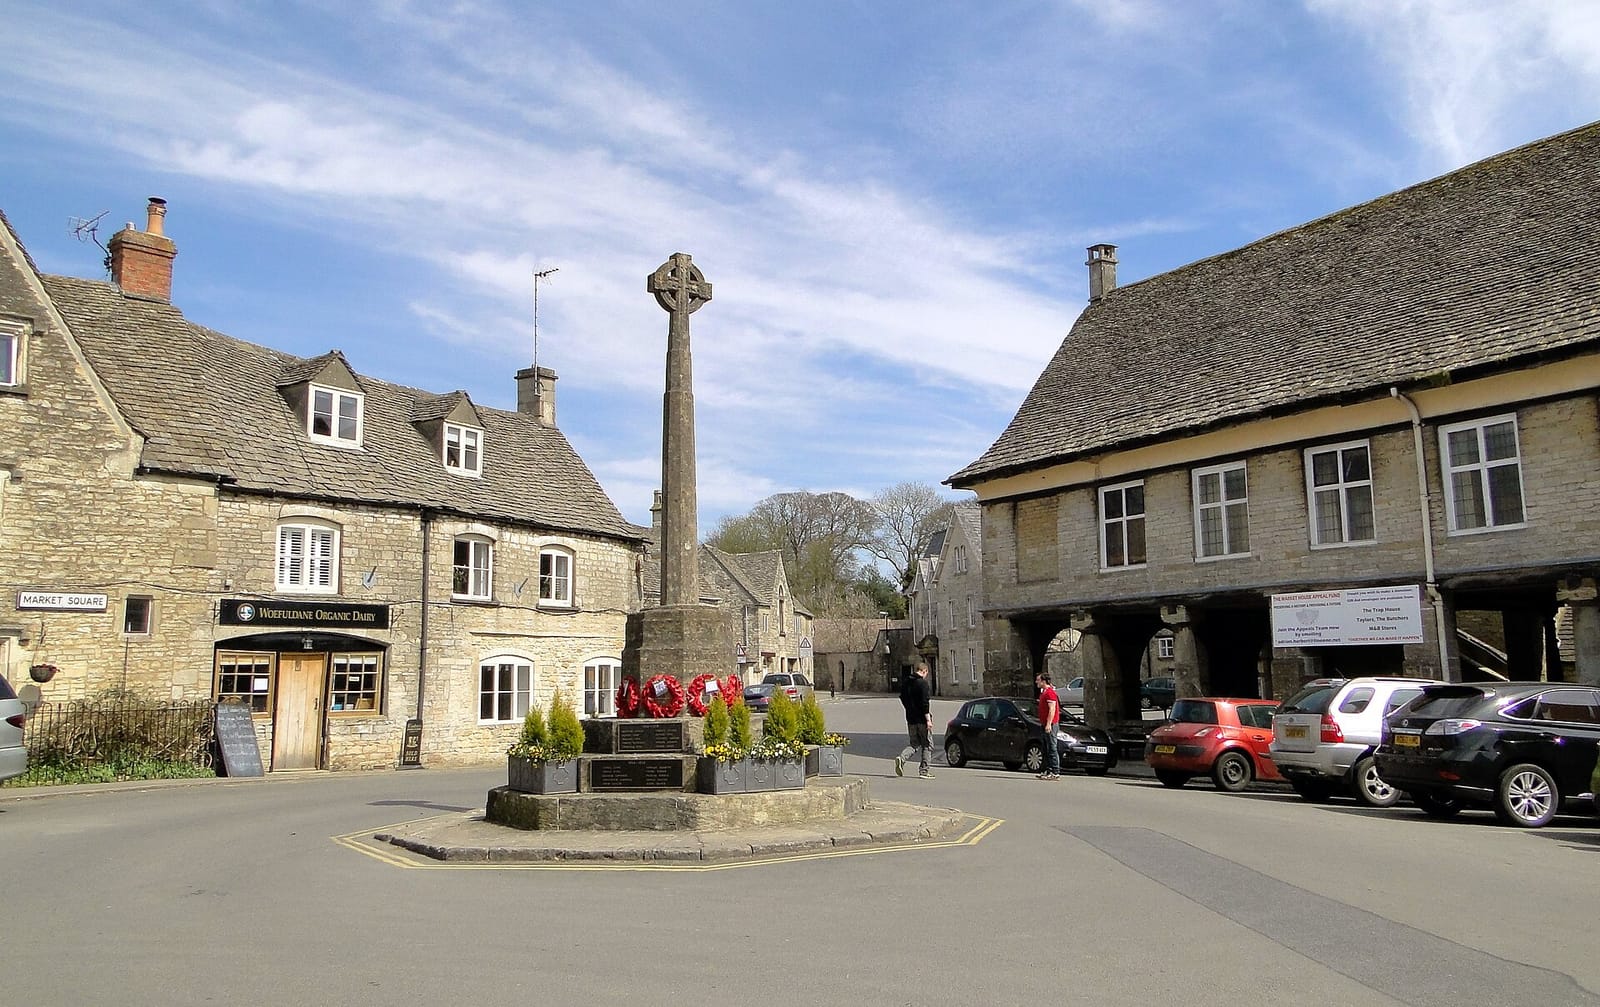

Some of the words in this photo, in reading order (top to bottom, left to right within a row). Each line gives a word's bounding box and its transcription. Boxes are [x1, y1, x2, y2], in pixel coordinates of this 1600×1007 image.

[23, 595, 63, 604] MARKET
[68, 596, 104, 606] SQUARE
[260, 608, 314, 620] WOEFULDANE
[316, 609, 352, 620] ORGANIC
[352, 610, 376, 622] DAIRY
